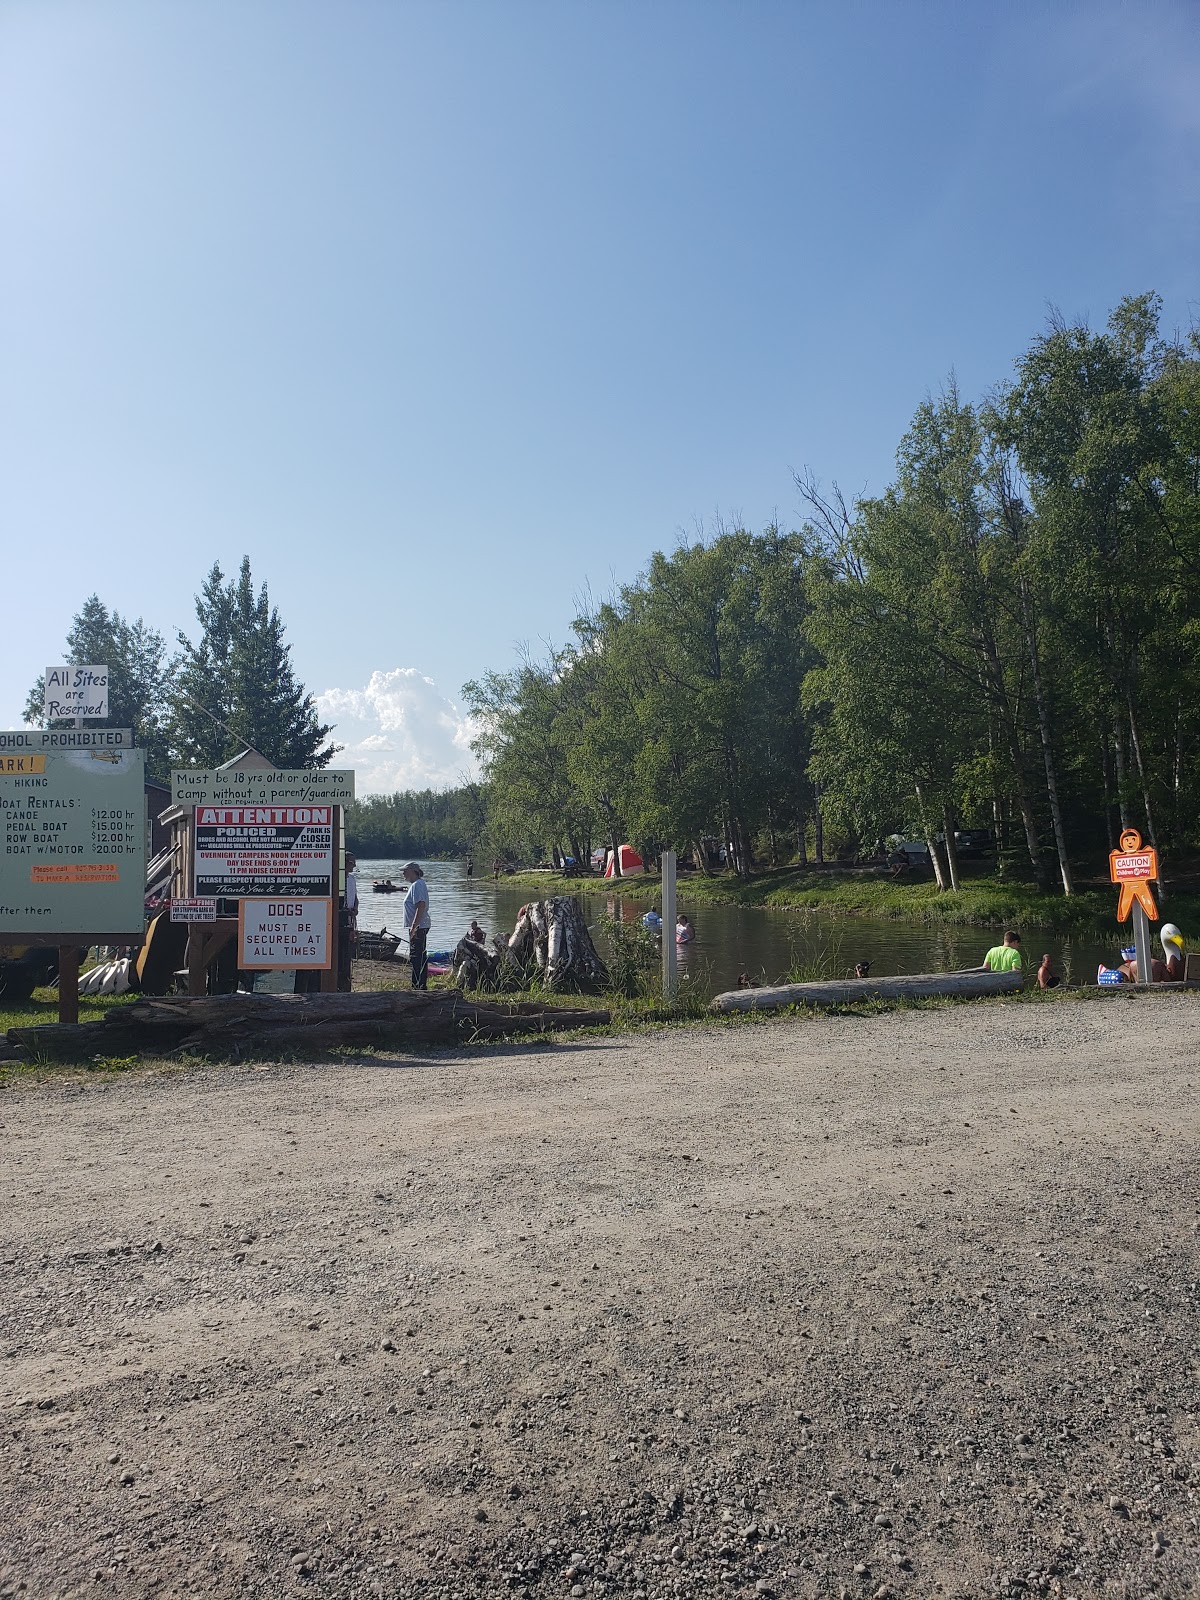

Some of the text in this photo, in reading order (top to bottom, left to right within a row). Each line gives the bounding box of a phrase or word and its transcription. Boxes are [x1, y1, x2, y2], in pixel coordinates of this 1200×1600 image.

[48, 670, 107, 687] All Sites
[65, 690, 84, 699] are
[48, 700, 103, 716] Reserved
[42, 733, 122, 746] PROHIBITED
[14, 779, 48, 788] HIKING
[177, 773, 344, 785] Must be 18 yrs old or older to
[177, 786, 351, 803] Camp without a parent/guardian
[0, 797, 21, 808] OAT
[6, 808, 134, 819] CANOE $12.00 hr
[201, 809, 328, 824] ATTENTION
[6, 820, 134, 831] PEDAL BOAT $15.00 hr
[6, 832, 134, 842] ROW BOAT $12.00 hr
[216, 828, 277, 836] POLICED
[301, 835, 331, 843] CLOSED
[6, 844, 136, 854] BOAT w/MOTOR $20.00 hr
[1117, 858, 1149, 867] CAUTION
[215, 885, 310, 896] Thank You & Enjoy
[24, 906, 52, 915] them
[268, 904, 302, 916] DOGS
[259, 924, 312, 932] MUST BE
[246, 935, 321, 944] SECURED AT
[254, 947, 316, 955] ALL TIMES
